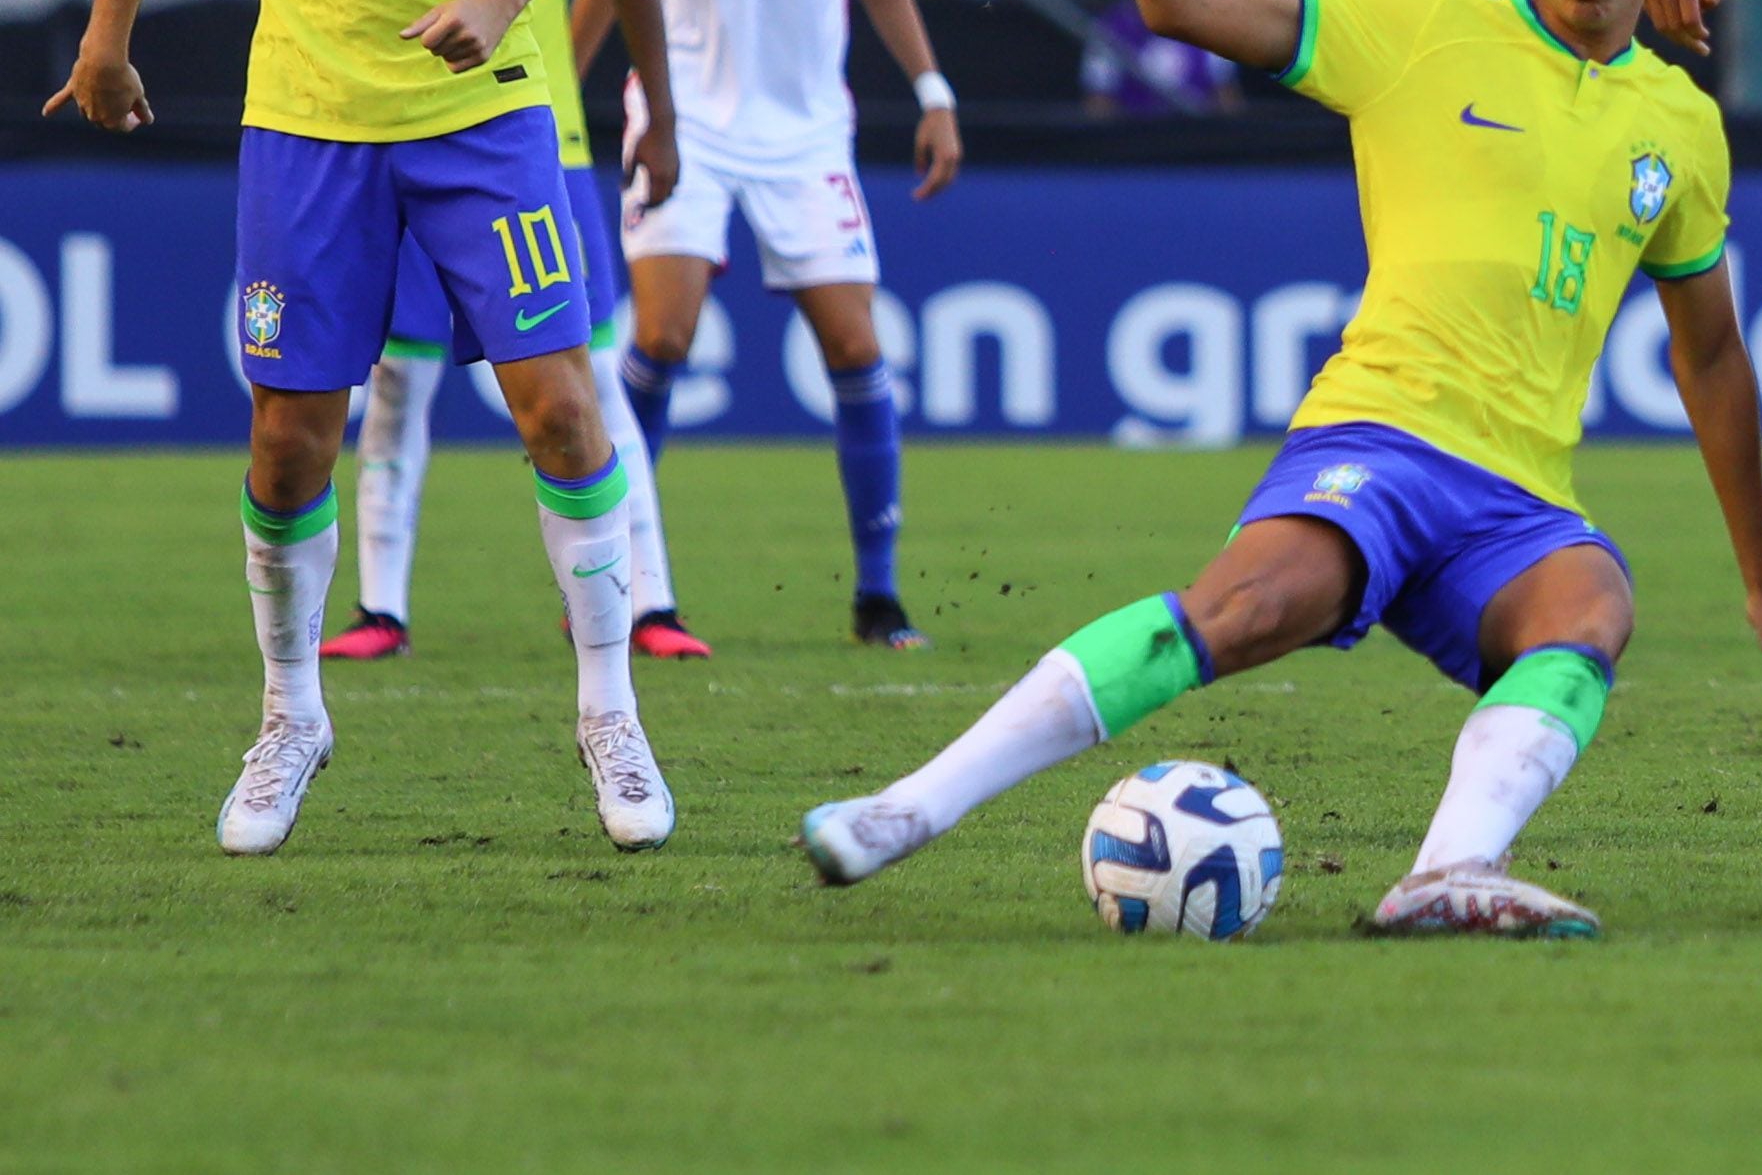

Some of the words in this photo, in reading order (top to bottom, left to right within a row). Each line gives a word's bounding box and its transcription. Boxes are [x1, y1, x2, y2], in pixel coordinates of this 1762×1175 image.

[826, 173, 863, 232] 3
[492, 204, 571, 299] 10
[1530, 210, 1596, 315] 18
